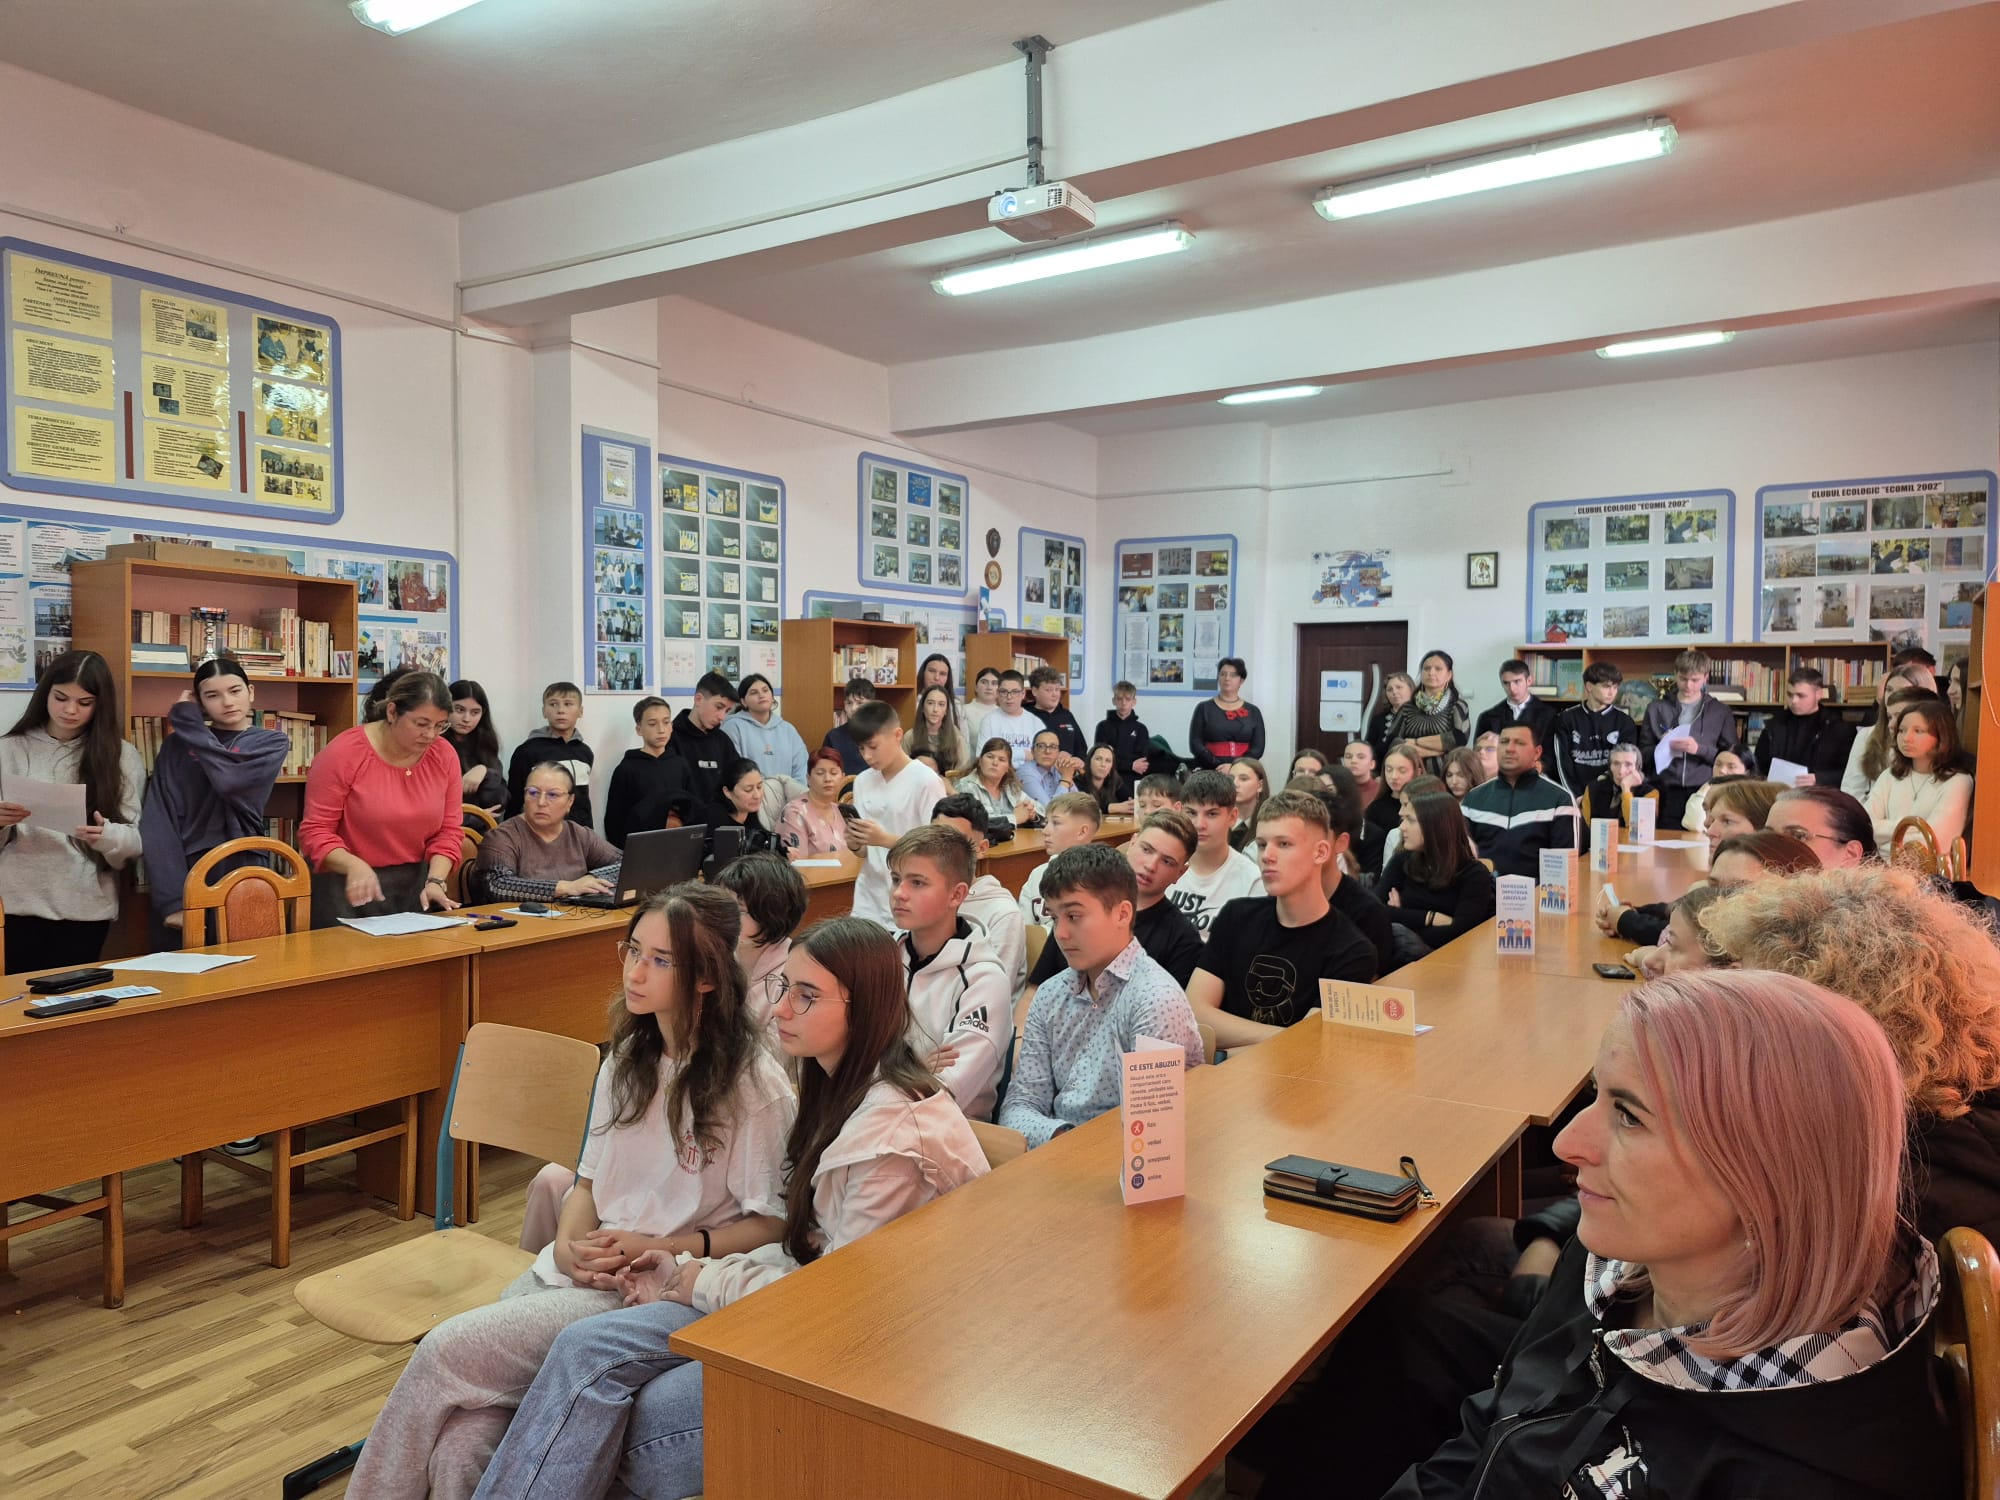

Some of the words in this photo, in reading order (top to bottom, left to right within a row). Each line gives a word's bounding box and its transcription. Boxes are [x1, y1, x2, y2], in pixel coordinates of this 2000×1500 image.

[1811, 489, 1841, 498] CLUBUL
[1841, 486, 1880, 497] ECOLOGIC
[1577, 506, 1602, 515] CLUBUL
[1603, 503, 1637, 513] ECOLOGIC
[1171, 889, 1207, 912] JUST
[1139, 1062, 1154, 1070] ESTE
[1155, 1060, 1180, 1069] ABUZUL?
